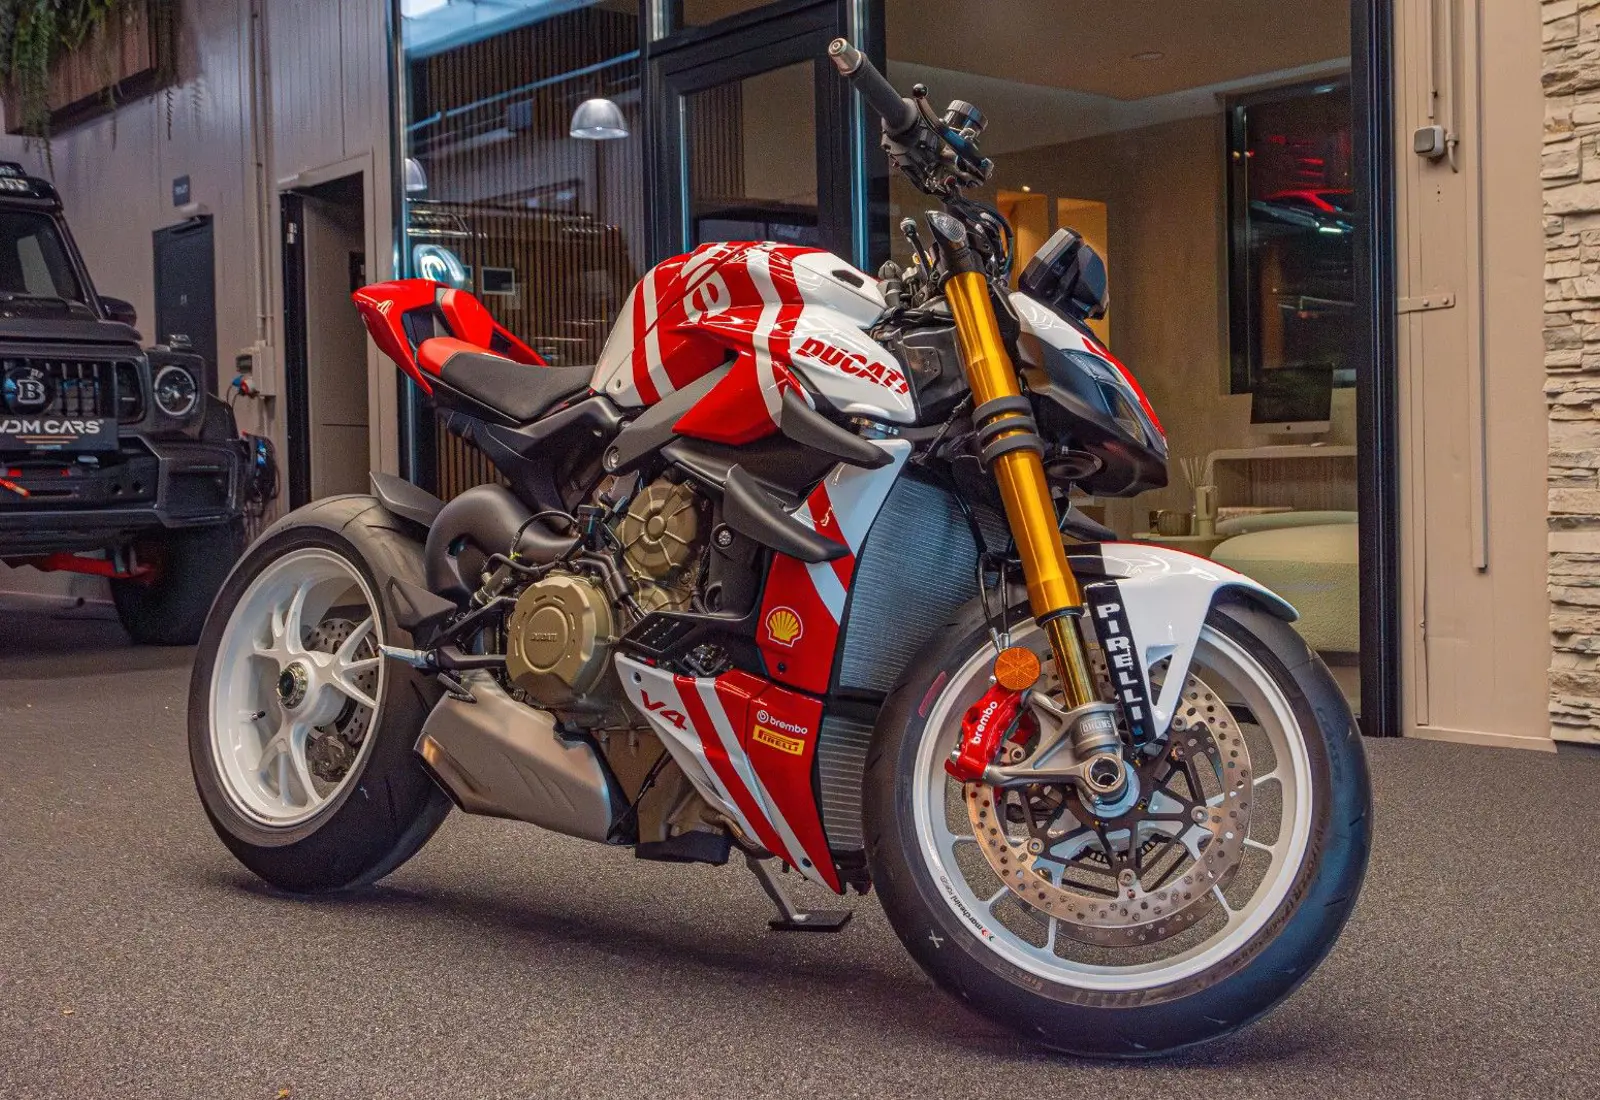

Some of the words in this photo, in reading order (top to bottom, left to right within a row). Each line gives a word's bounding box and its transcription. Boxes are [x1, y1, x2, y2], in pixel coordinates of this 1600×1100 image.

[795, 337, 910, 395] DUCATI
[0, 419, 41, 434] VDM
[43, 419, 101, 434] CARS
[1096, 602, 1143, 721] PIRELLI
[640, 689, 687, 730] V4
[769, 715, 808, 735] brembo
[969, 701, 998, 744] brembo
[757, 729, 800, 753] PIRELLI
[950, 895, 983, 930] marchesini
